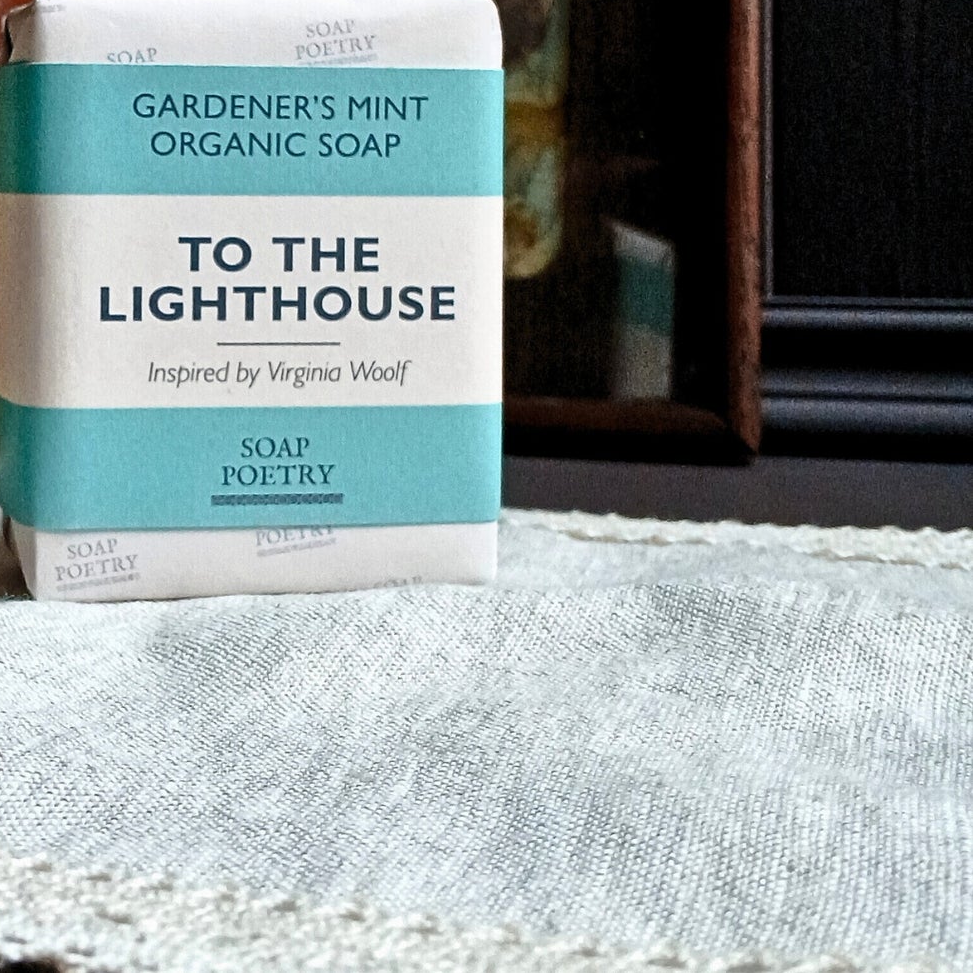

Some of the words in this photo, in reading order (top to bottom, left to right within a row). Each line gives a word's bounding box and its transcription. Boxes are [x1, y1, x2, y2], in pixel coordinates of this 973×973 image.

[305, 18, 355, 38] SOAP
[106, 46, 158, 63] SOAP
[294, 34, 375, 60] POETRY
[132, 93, 335, 121] GARDENER'S
[348, 95, 429, 121] MINT
[150, 131, 307, 158] ORGANIC
[318, 132, 401, 158] SOAP
[177, 236, 252, 273] TO
[271, 236, 380, 273] THE
[99, 285, 455, 322] LIGHTHOUSE
[147, 360, 230, 388] Inspired
[236, 361, 261, 388] by
[267, 361, 342, 388] Virginia
[349, 360, 413, 386] Woolf
[240, 436, 310, 459] SOAP
[221, 463, 336, 487] POETRY
[67, 538, 118, 560] SOAP
[54, 554, 139, 582] POETRY
